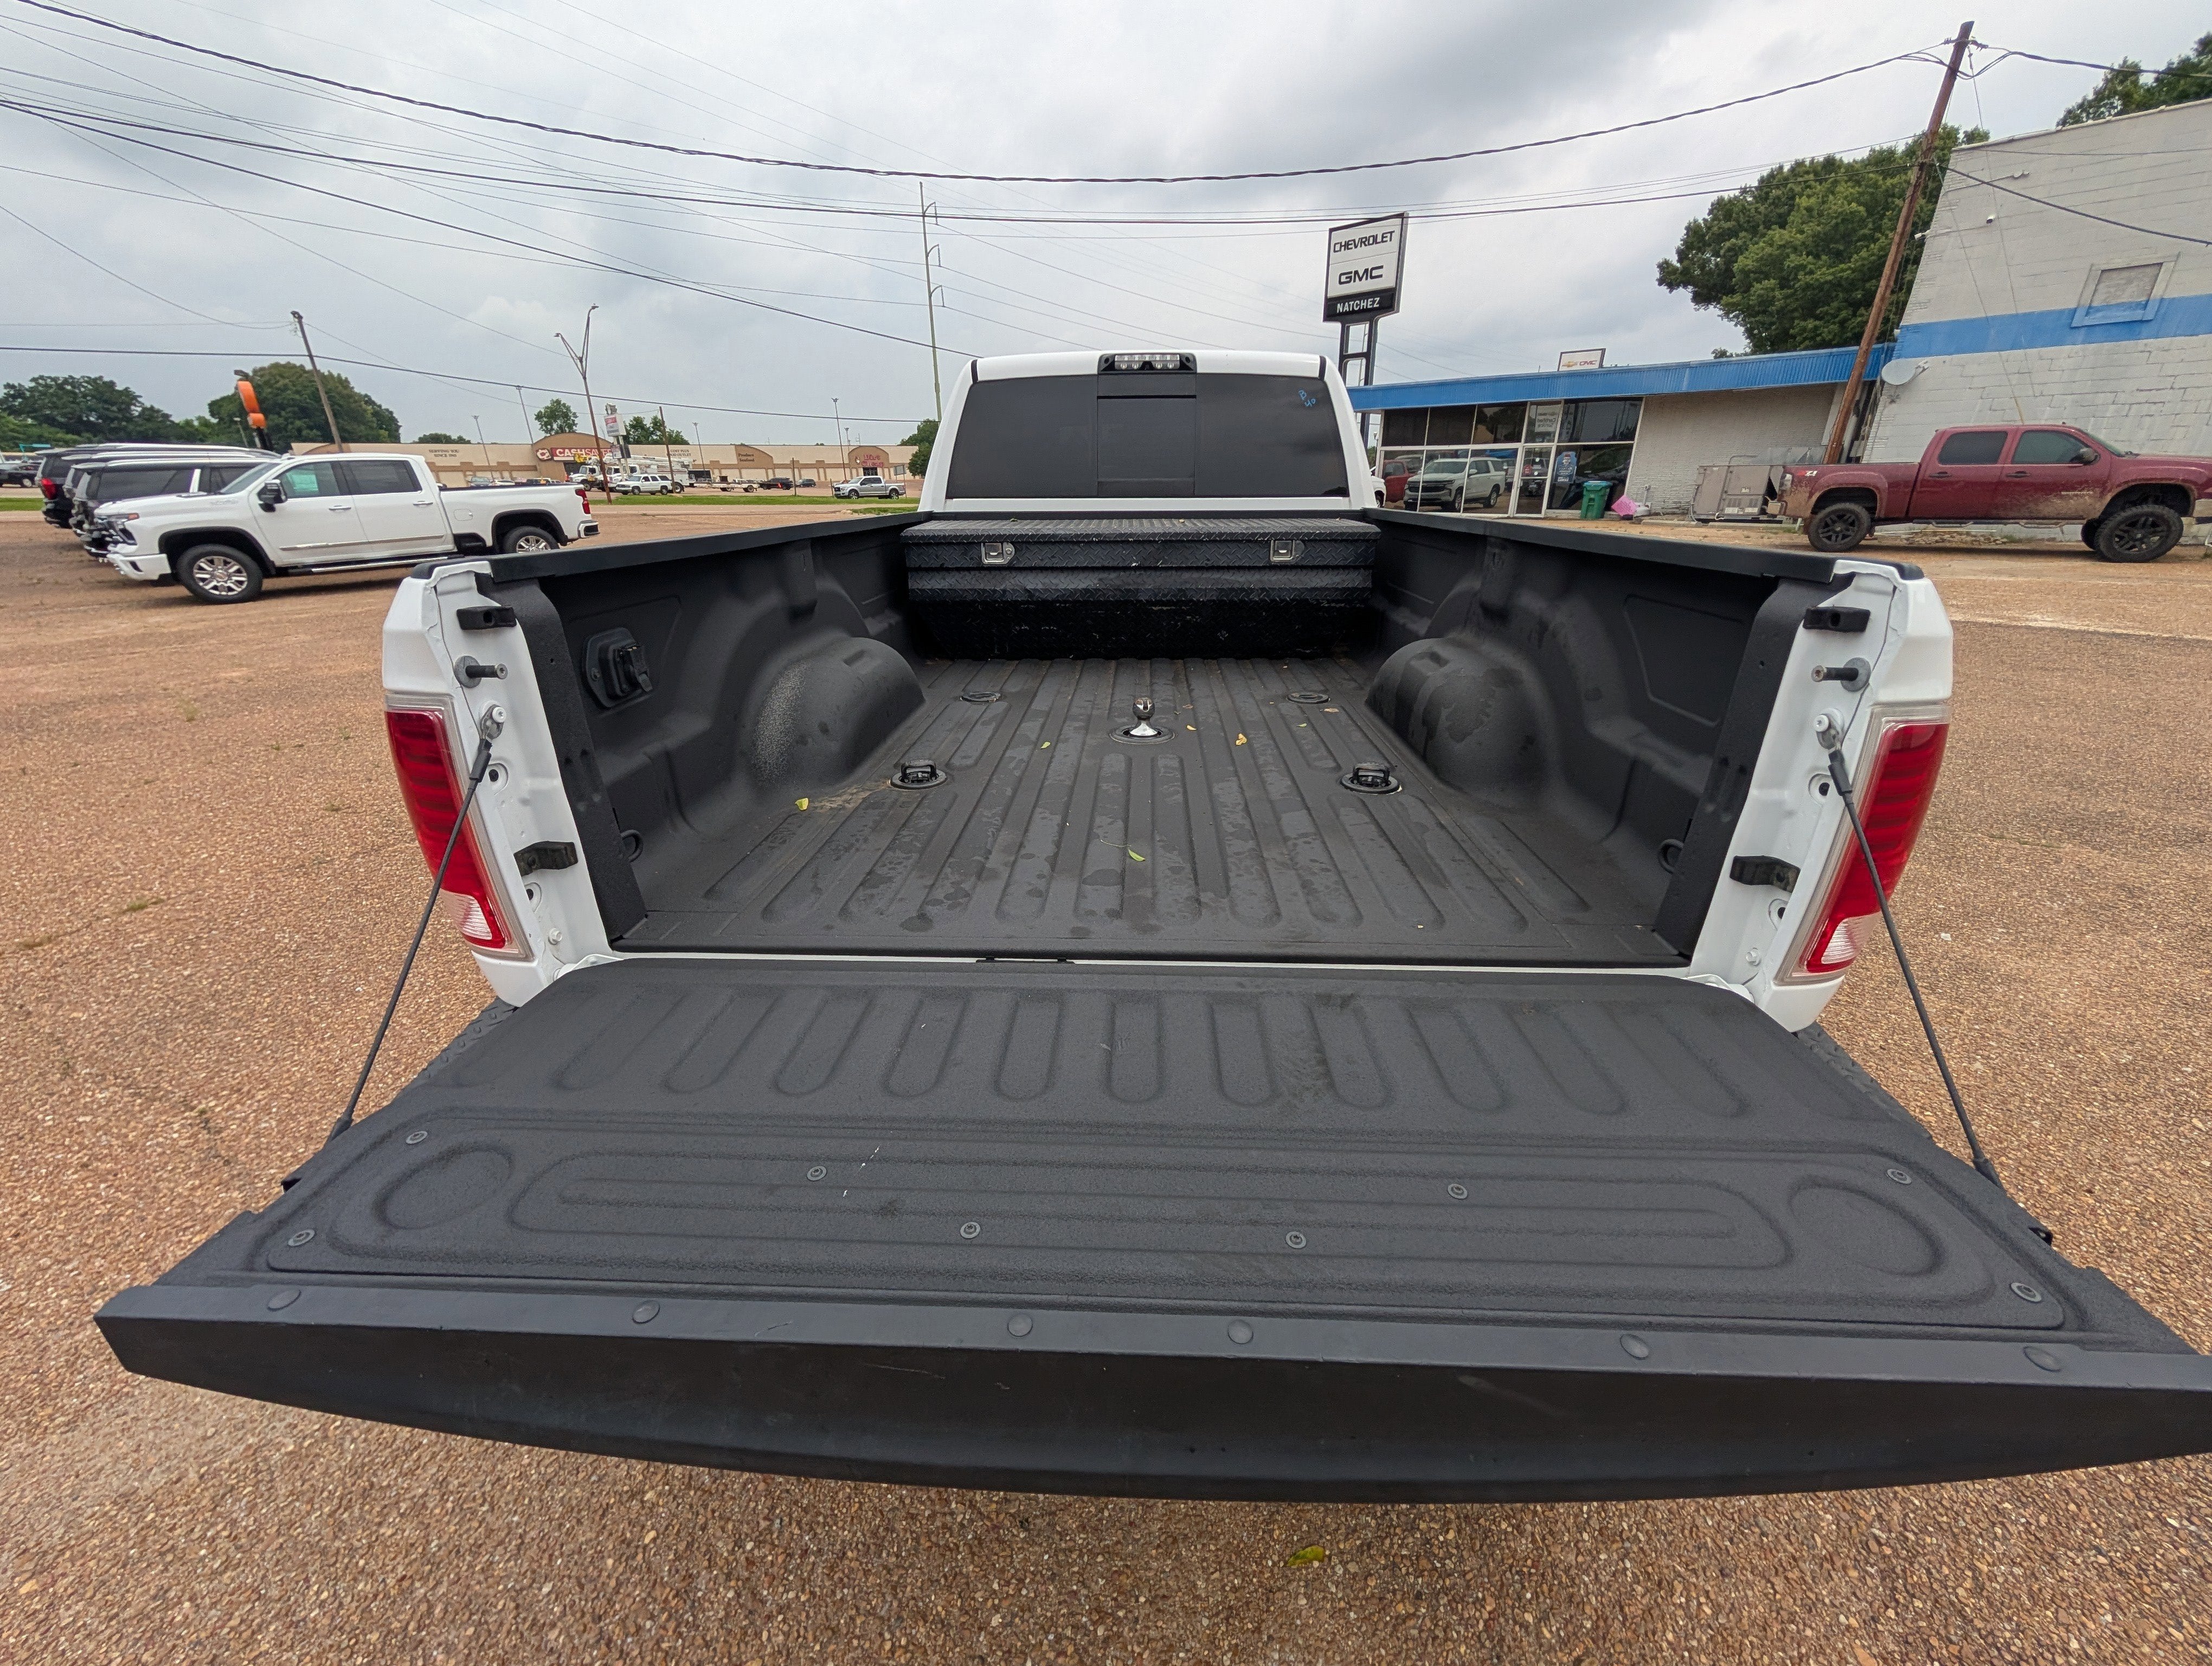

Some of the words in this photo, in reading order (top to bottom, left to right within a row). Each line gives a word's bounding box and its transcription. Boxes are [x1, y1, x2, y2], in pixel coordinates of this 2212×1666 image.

[1333, 230, 1395, 253] CHEVROLET
[1338, 265, 1384, 285] GMC
[1337, 297, 1380, 313] NATCHEZ
